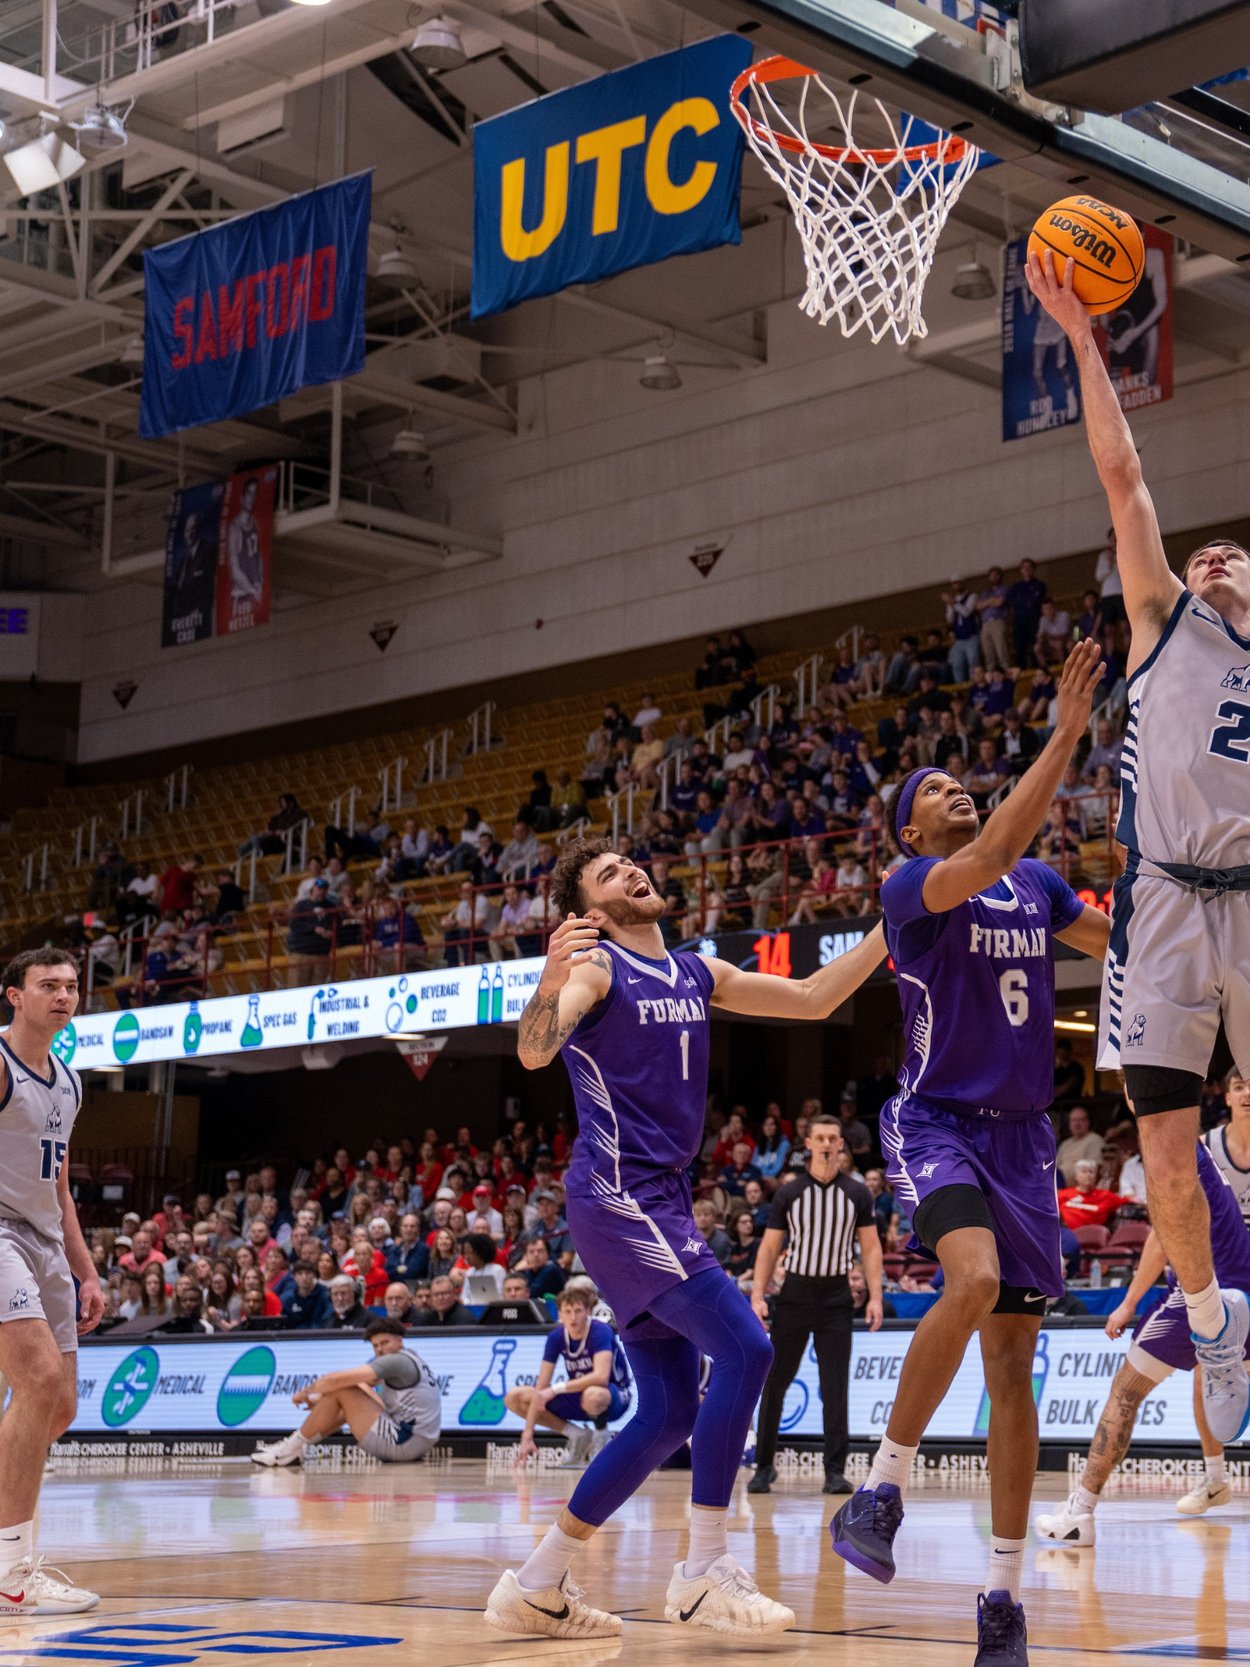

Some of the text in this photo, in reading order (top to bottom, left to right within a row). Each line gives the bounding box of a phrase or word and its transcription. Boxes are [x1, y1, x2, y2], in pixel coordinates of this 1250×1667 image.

[501, 97, 720, 262] UTC
[1075, 197, 1129, 230] NCAA
[1049, 214, 1117, 269] Wilson
[172, 245, 336, 369] SAMFORD
[818, 930, 865, 967] SAM
[969, 923, 1046, 958] FURMAN
[753, 932, 792, 978] 14
[421, 982, 461, 999] BEVERAGE
[999, 969, 1029, 1026] 6
[319, 995, 369, 1013] INDUSTRIAL &
[201, 1019, 233, 1035] PROPANE
[263, 1012, 297, 1029] SPEC GAS
[432, 1009, 447, 1023] CO2
[140, 1025, 174, 1040] BANDSAW
[327, 1021, 360, 1036] WELDING
[77, 1034, 104, 1048] MEDICAL
[680, 1030, 689, 1080] 1
[40, 1138, 67, 1183] 15
[854, 1356, 902, 1380] BEVE
[153, 1374, 206, 1396] MEDICAL
[1046, 1399, 1098, 1425] BULK
[81, 1442, 128, 1457] CHEROKEE
[129, 1442, 165, 1456] CENTER
[172, 1442, 224, 1456] ASHEVILLE
[938, 1454, 988, 1471] ASHEV
[1122, 1458, 1205, 1475] CHEROKEE
